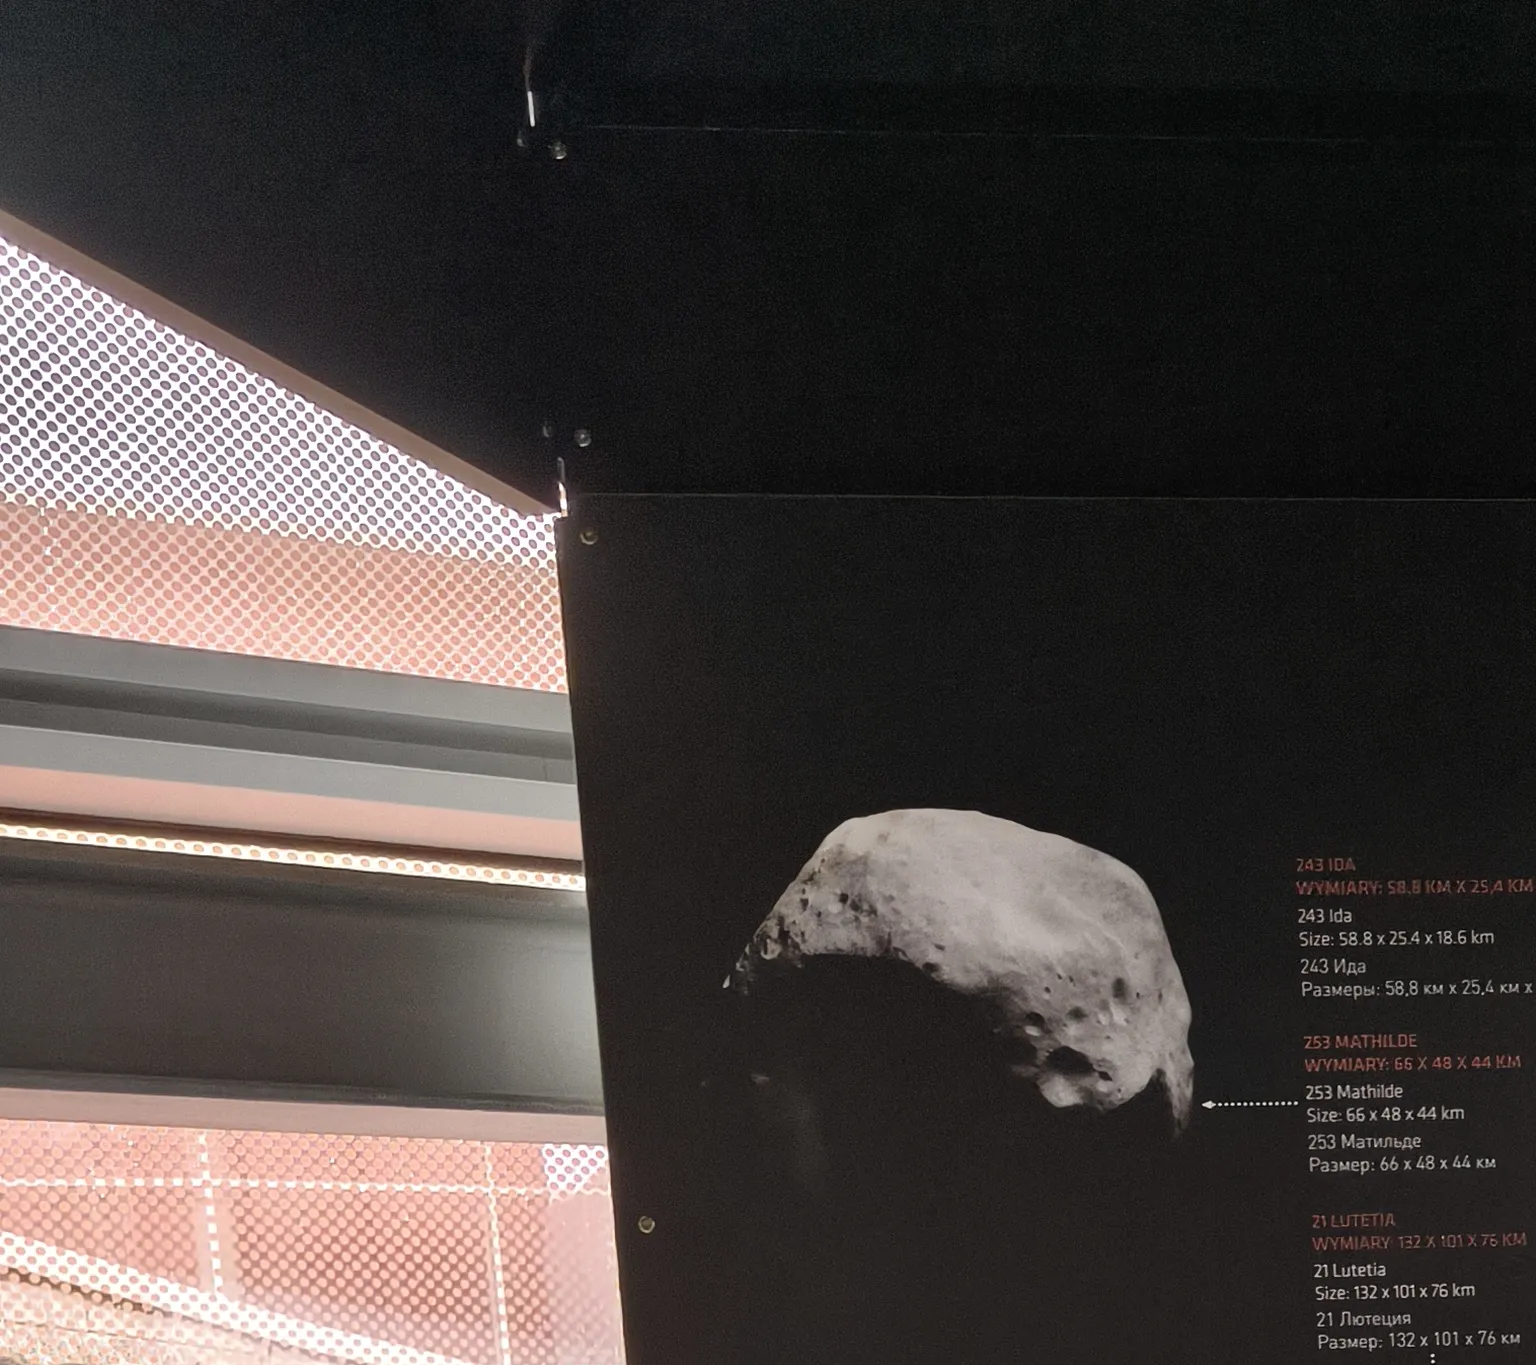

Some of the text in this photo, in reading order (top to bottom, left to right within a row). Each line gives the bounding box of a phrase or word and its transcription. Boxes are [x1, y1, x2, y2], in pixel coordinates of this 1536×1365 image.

[1296, 858, 1356, 872] 243 IDA
[1296, 880, 1383, 895] WYMIARY:
[1425, 880, 1452, 893] KM
[1456, 879, 1466, 893] X
[1508, 878, 1534, 892] KM
[1297, 908, 1353, 923] 243 Ida
[1298, 930, 1495, 947] Size: 58.8 x 25.4 x 18.6 km
[1300, 959, 1367, 976] 243 Ида
[1301, 981, 1381, 1000] Размеры:
[1385, 980, 1419, 997] 58,8
[1423, 982, 1444, 995] км
[1461, 979, 1495, 996] 25,4
[1499, 982, 1520, 994] км
[1303, 1034, 1418, 1049] 253 MATHILDE
[1304, 1055, 1522, 1073] WYMIARY: 66 X 48 X 44 KM
[1305, 1084, 1404, 1100] 253 Mathilde
[1306, 1105, 1465, 1123] Size: 66 x 48 x 44 km
[1308, 1134, 1422, 1150] 253 Матильде
[1309, 1157, 1376, 1176] Размер:
[1379, 1156, 1399, 1171] 66
[1416, 1156, 1436, 1170] 48
[1452, 1155, 1472, 1169] 44
[1476, 1157, 1497, 1169] км
[1312, 1213, 1396, 1228] 21 LUTETIA
[1398, 1235, 1421, 1249] 132
[1426, 1234, 1436, 1248] X
[1441, 1234, 1463, 1248] 101
[1468, 1233, 1476, 1247] X
[1481, 1233, 1499, 1246] 76
[1502, 1232, 1528, 1246] KM
[1313, 1263, 1387, 1278] 21 Lutetia
[1315, 1283, 1476, 1301] Size: 132 x 101 x 76 km
[1316, 1311, 1412, 1328] 21 Лютеция
[1318, 1335, 1383, 1353] Размер:
[1388, 1333, 1415, 1348] 132
[1434, 1332, 1460, 1347] 101
[1477, 1330, 1497, 1345] 76
[1501, 1332, 1521, 1344] км
